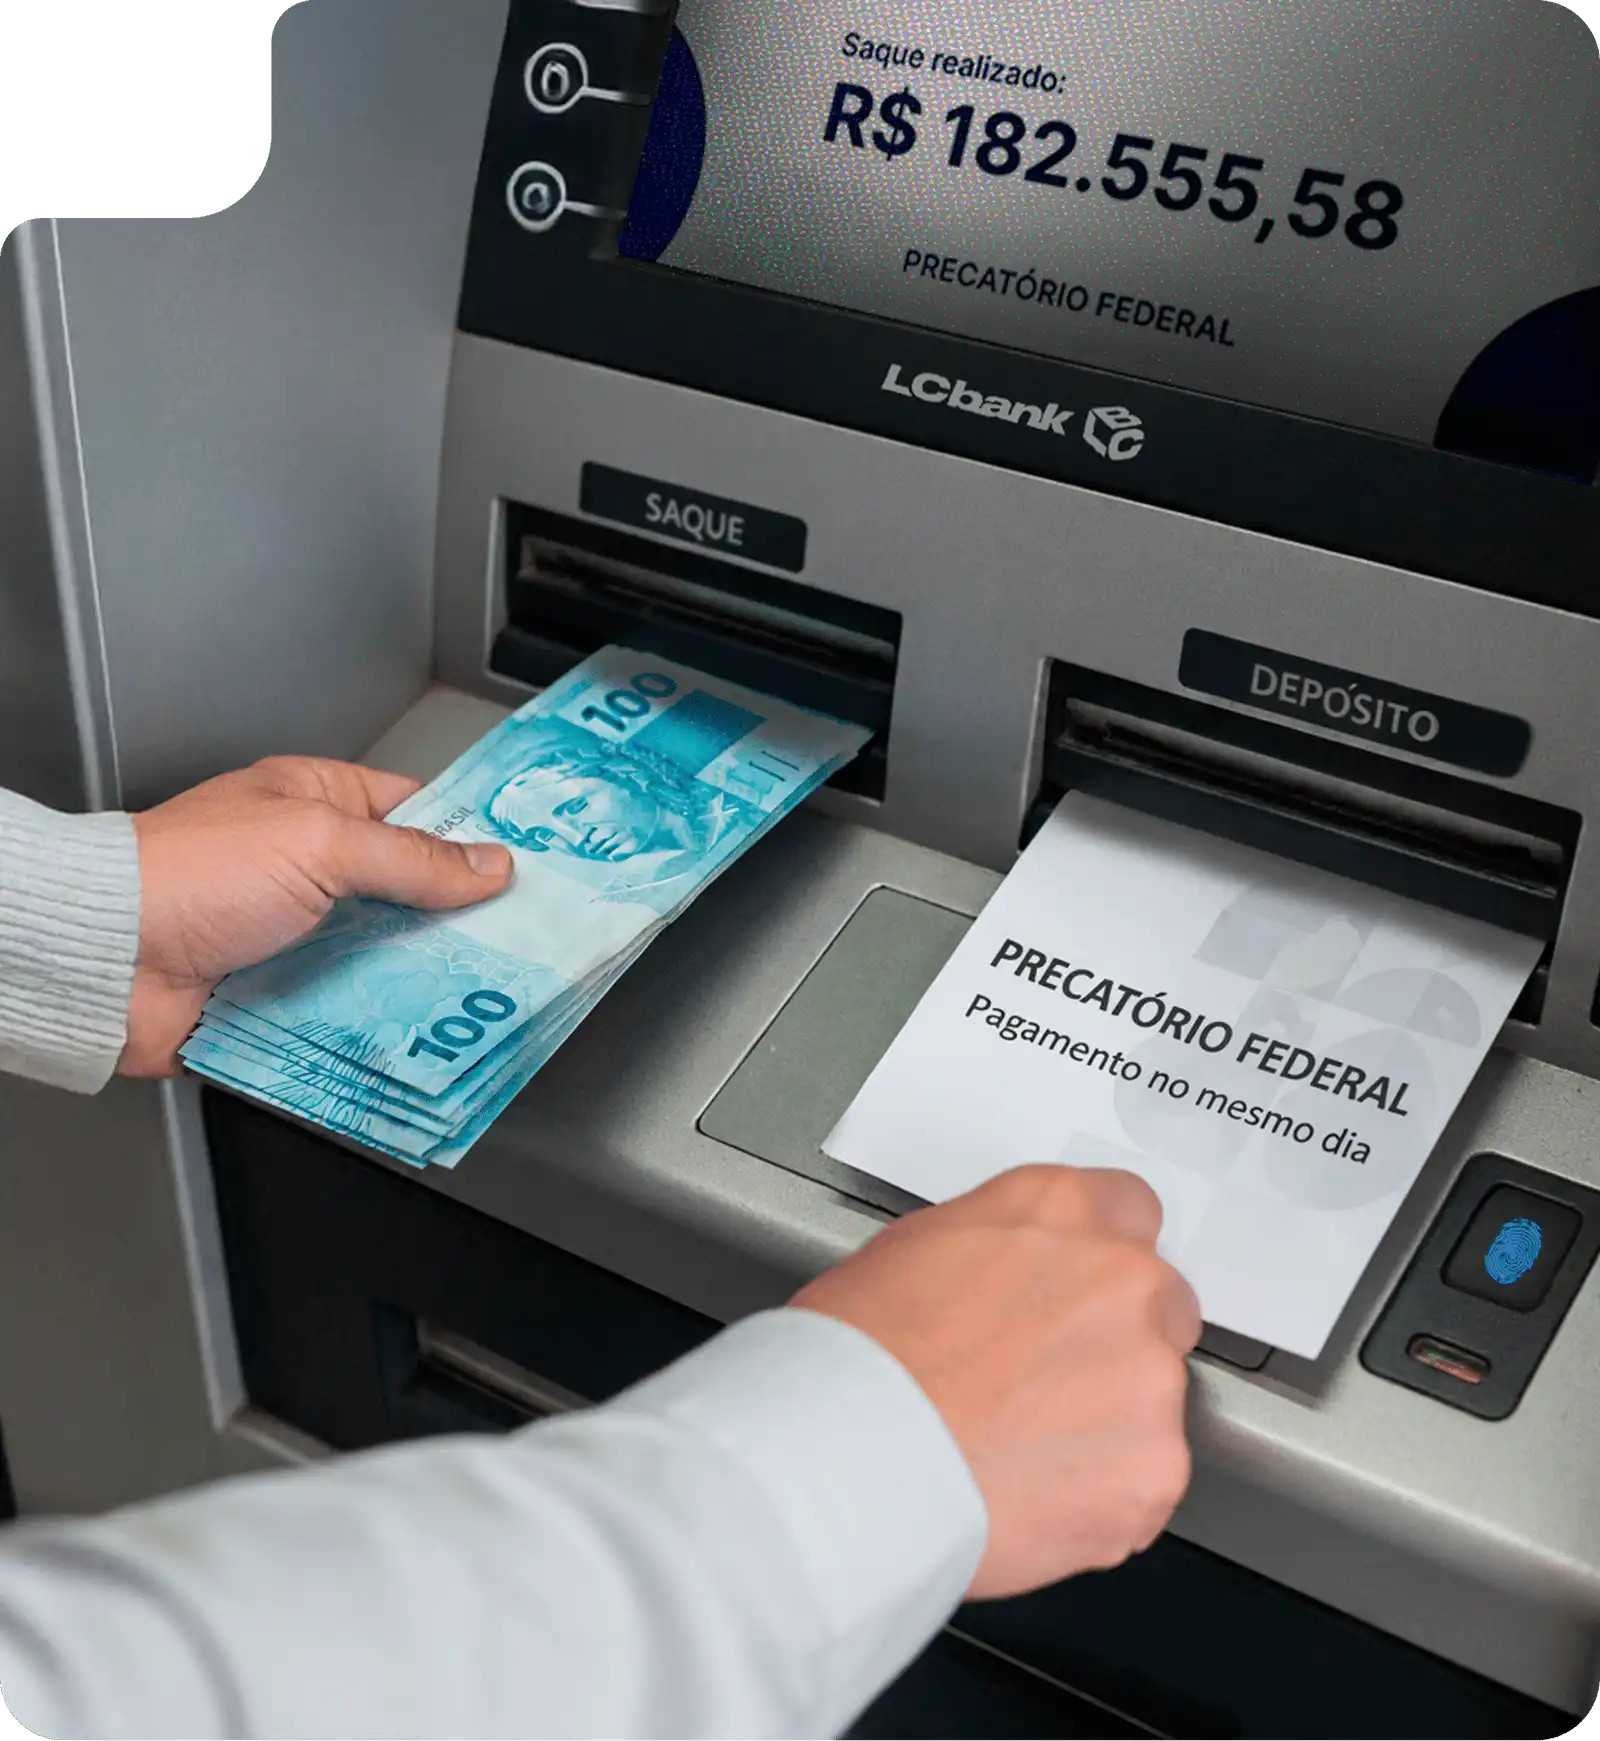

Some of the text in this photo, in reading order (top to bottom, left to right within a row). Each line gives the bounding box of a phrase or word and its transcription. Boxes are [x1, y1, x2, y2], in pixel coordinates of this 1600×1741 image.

[841, 32, 1066, 95] Saque realizado:
[822, 81, 1404, 251] R$ 182.555,58
[902, 249, 1234, 347] PRECATÓRIO FEDERAL
[881, 363, 1074, 435] LCbank
[645, 493, 744, 545] SAQUE
[581, 673, 677, 732] 100
[1250, 662, 1439, 743] DEPÓSITO
[408, 990, 517, 1063] 100
[990, 938, 1409, 1117] PRECATÓRIO FEDERAL
[965, 993, 1371, 1164] Pagamento no mesmo dia
